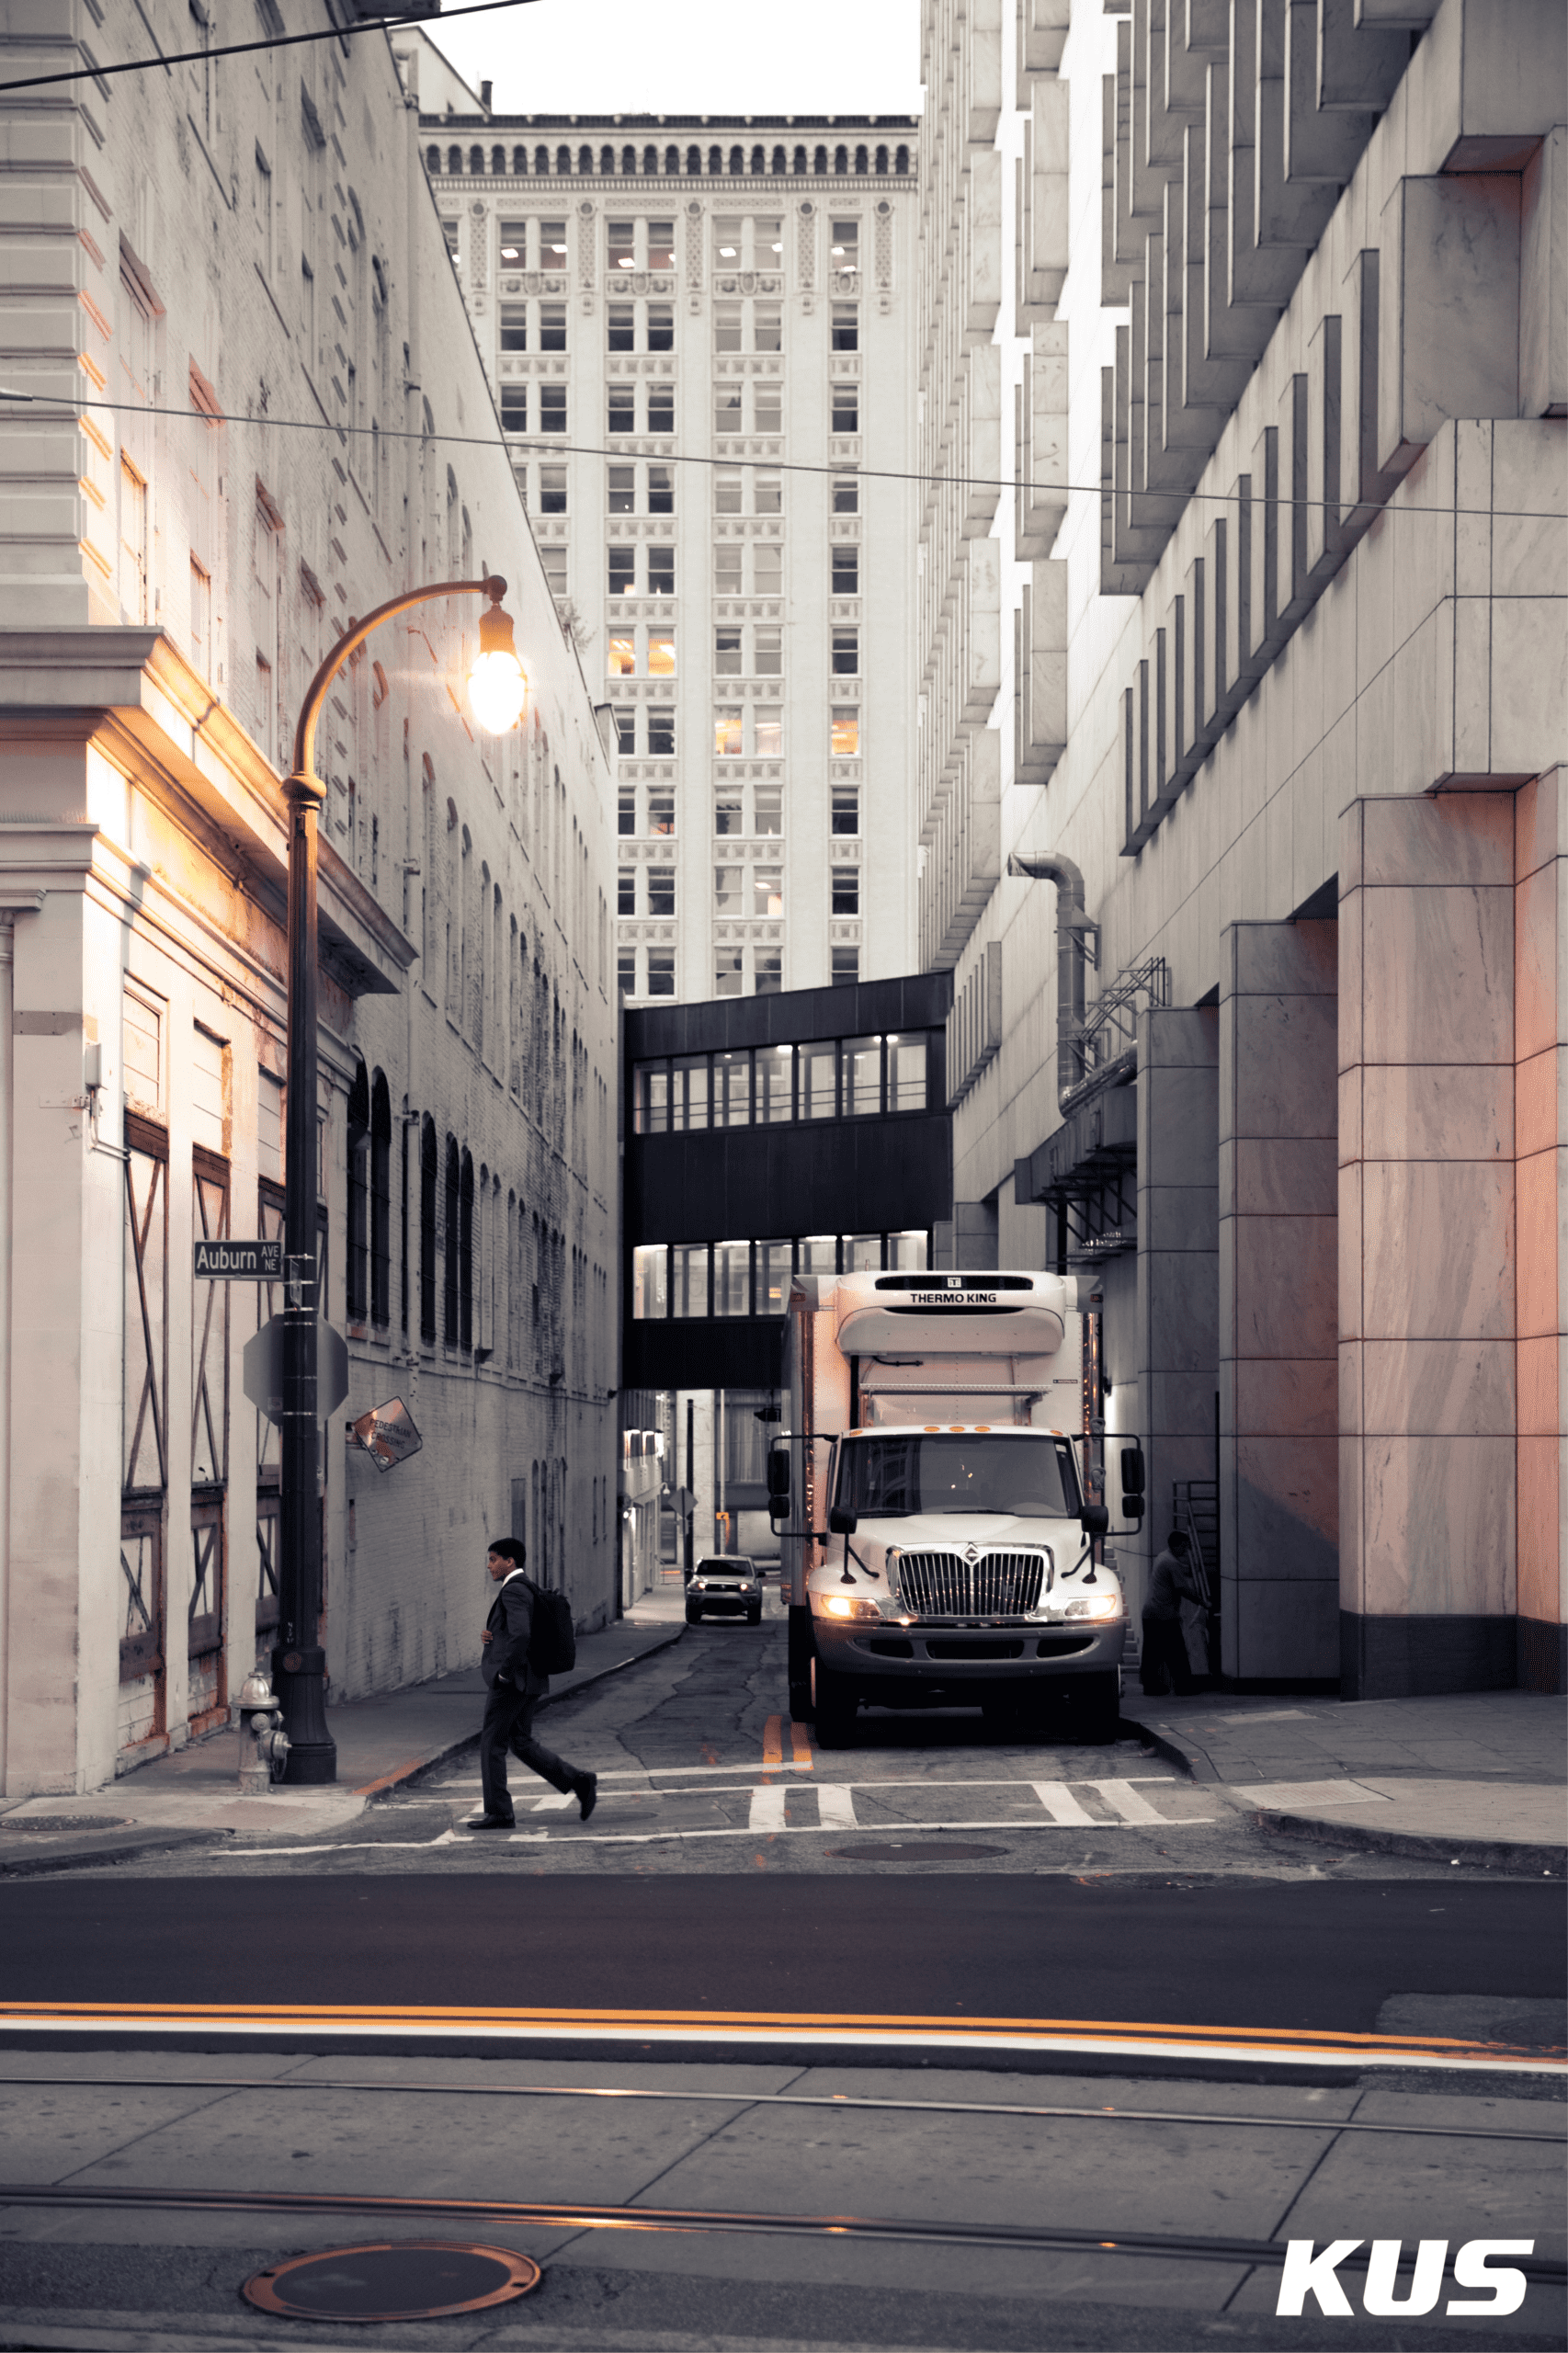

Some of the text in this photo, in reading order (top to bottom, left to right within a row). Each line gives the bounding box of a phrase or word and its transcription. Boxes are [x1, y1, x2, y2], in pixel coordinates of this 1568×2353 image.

[197, 1245, 279, 1269] Auburn AVE
[265, 1258, 277, 1271] NE
[910, 1293, 996, 1303] THERMO KING
[369, 1418, 412, 1438] PEDESTRIAN
[370, 1431, 405, 1449] CROSSING
